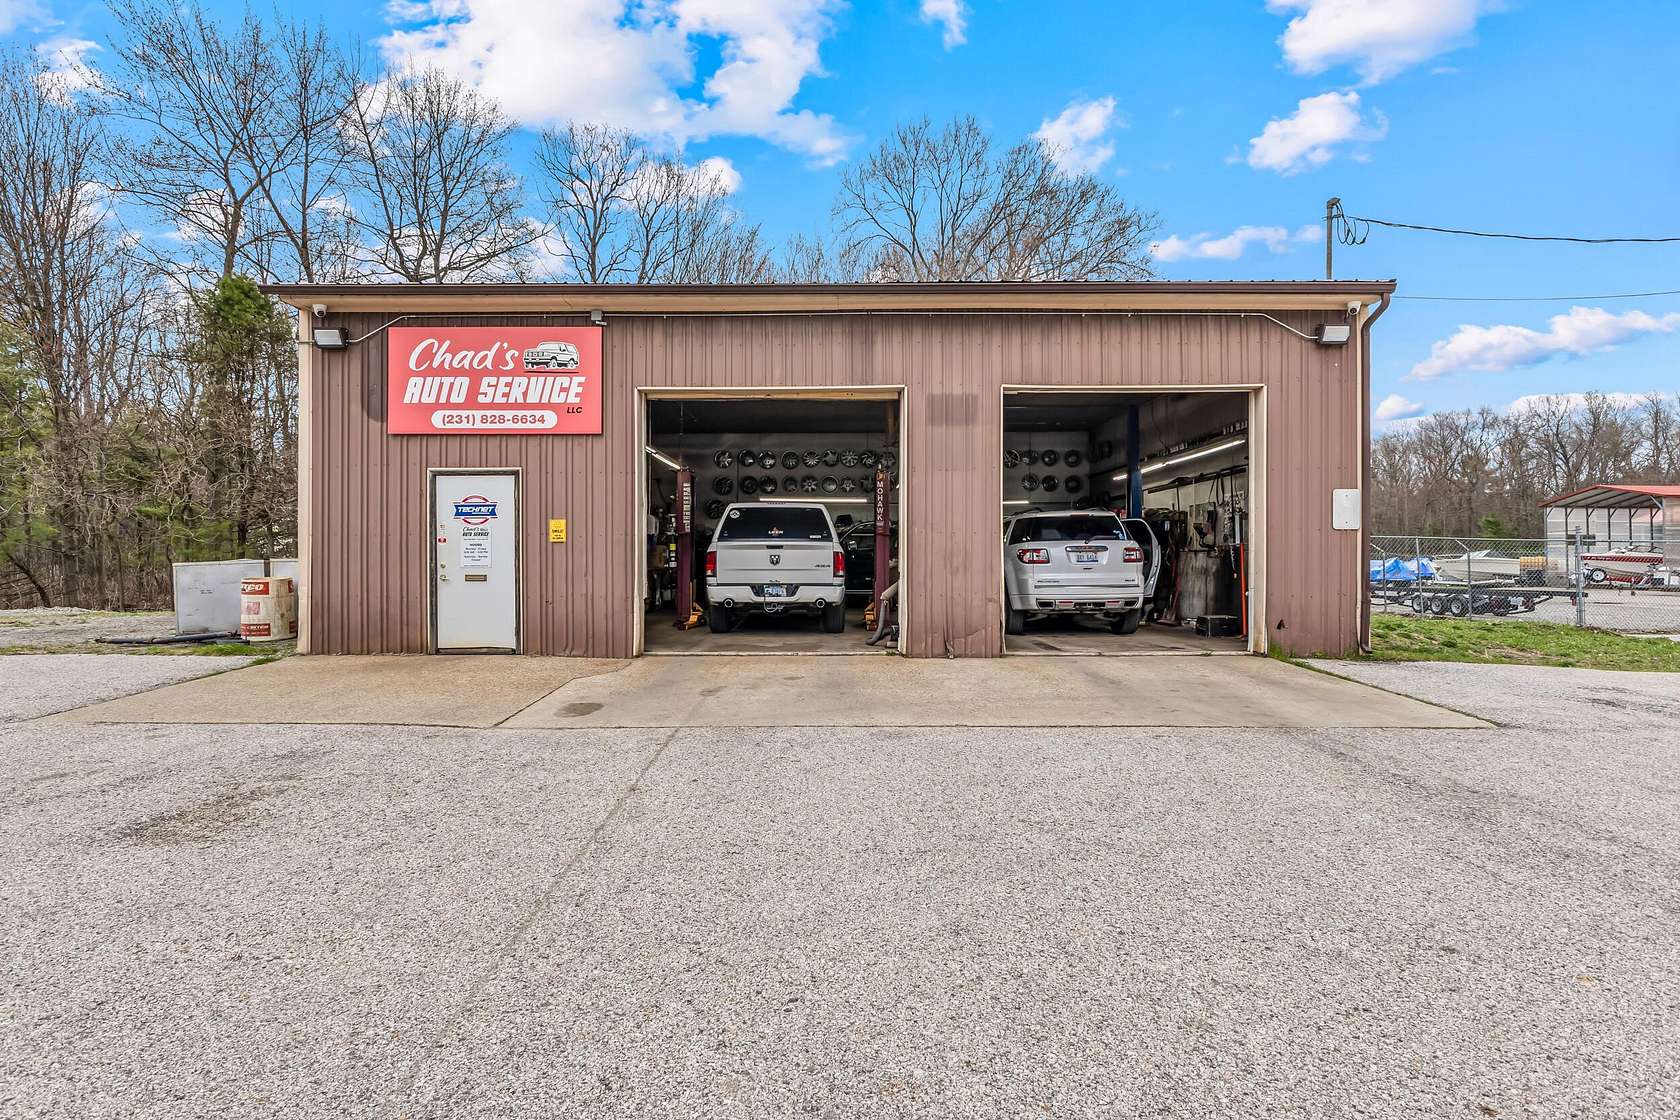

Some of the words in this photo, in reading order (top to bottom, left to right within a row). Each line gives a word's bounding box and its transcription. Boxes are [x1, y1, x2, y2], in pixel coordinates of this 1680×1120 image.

[408, 338, 519, 372] Chad's
[403, 376, 470, 404] AUTO
[477, 376, 586, 404] SERVICE
[442, 413, 476, 427] (231)
[480, 414, 546, 425] 828-6634
[566, 406, 583, 414] LLC
[876, 480, 885, 521] MOHAWK
